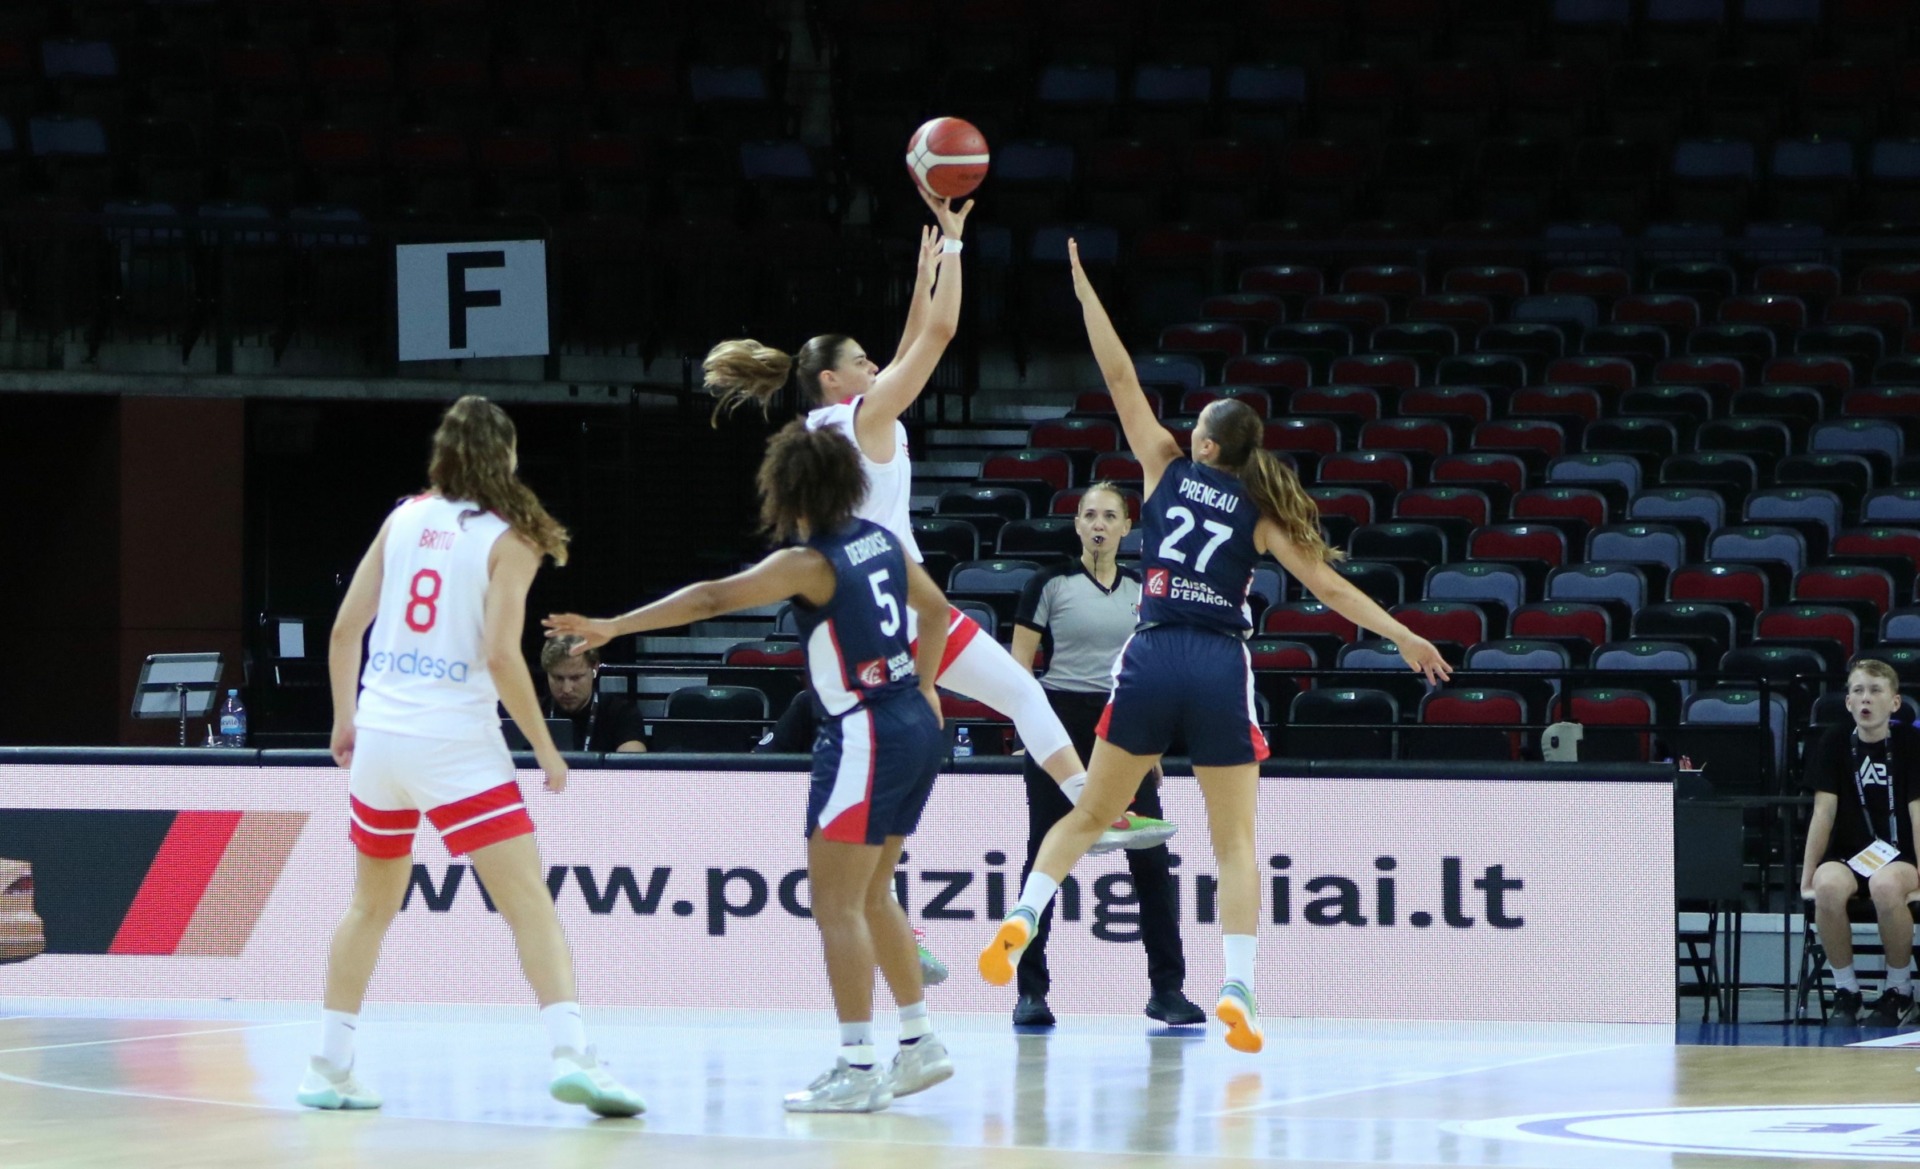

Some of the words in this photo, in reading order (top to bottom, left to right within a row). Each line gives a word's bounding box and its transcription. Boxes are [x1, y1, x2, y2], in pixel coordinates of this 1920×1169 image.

[447, 251, 505, 349] F
[1178, 478, 1239, 513] PRENEAU
[419, 528, 456, 551] BRITO
[1158, 506, 1234, 573] 27
[405, 568, 442, 634] 8
[868, 568, 900, 637] 5
